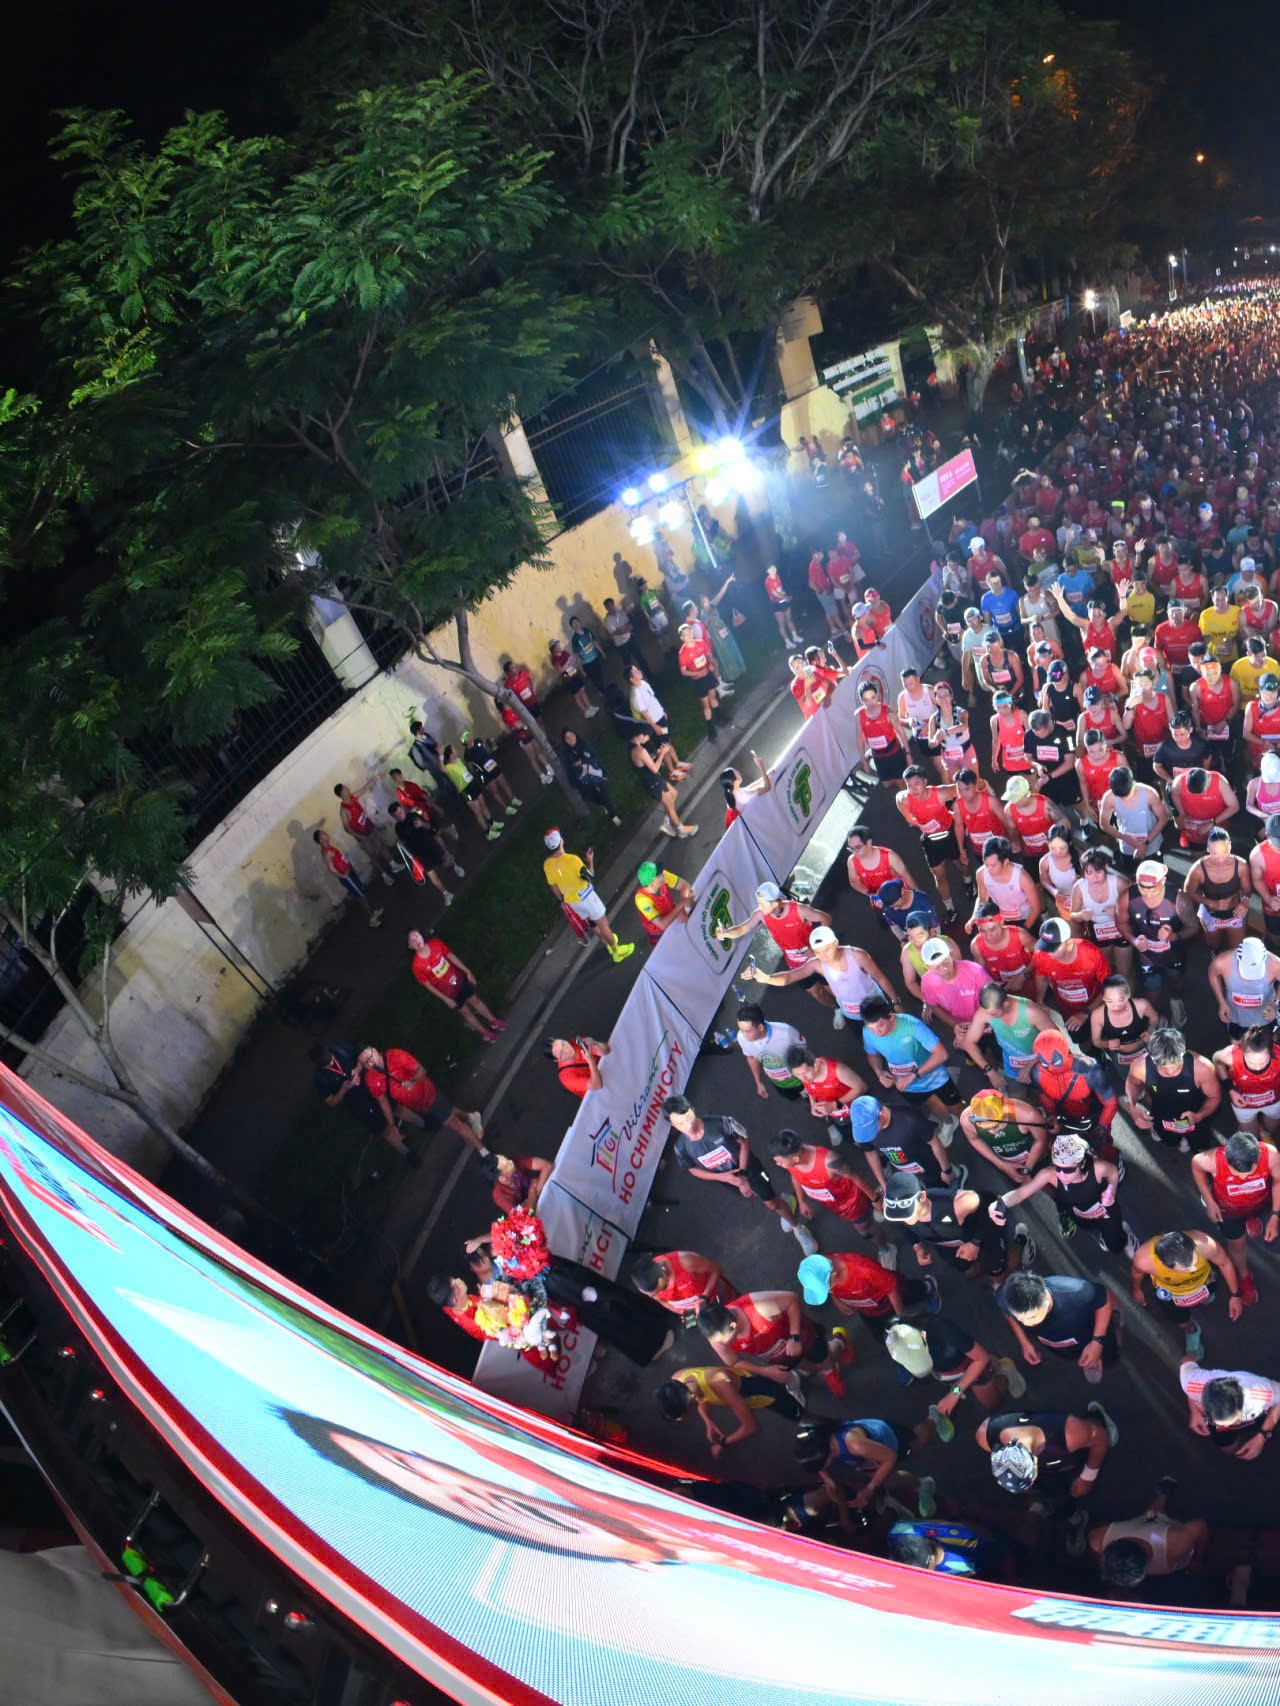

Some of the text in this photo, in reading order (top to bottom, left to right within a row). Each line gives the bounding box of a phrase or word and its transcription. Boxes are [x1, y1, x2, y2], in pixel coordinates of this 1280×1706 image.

[619, 1040, 683, 1204] HO CHI MINH CITY
